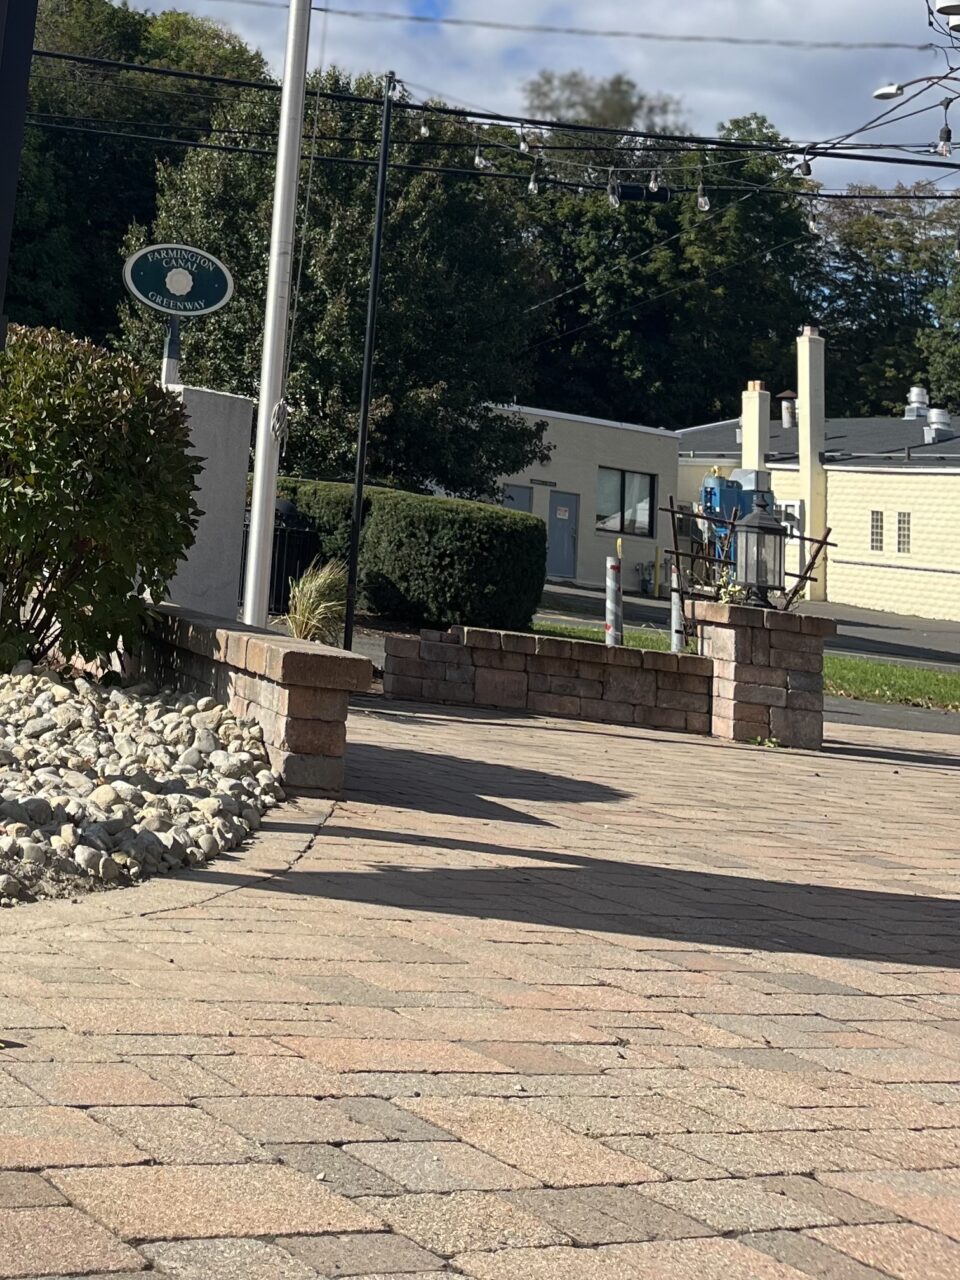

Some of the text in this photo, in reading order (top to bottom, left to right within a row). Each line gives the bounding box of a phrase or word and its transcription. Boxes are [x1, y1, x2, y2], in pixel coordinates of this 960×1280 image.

[147, 249, 216, 272] FARMINGTON
[162, 258, 198, 273] CANAL
[148, 291, 206, 311] GREENWAY
